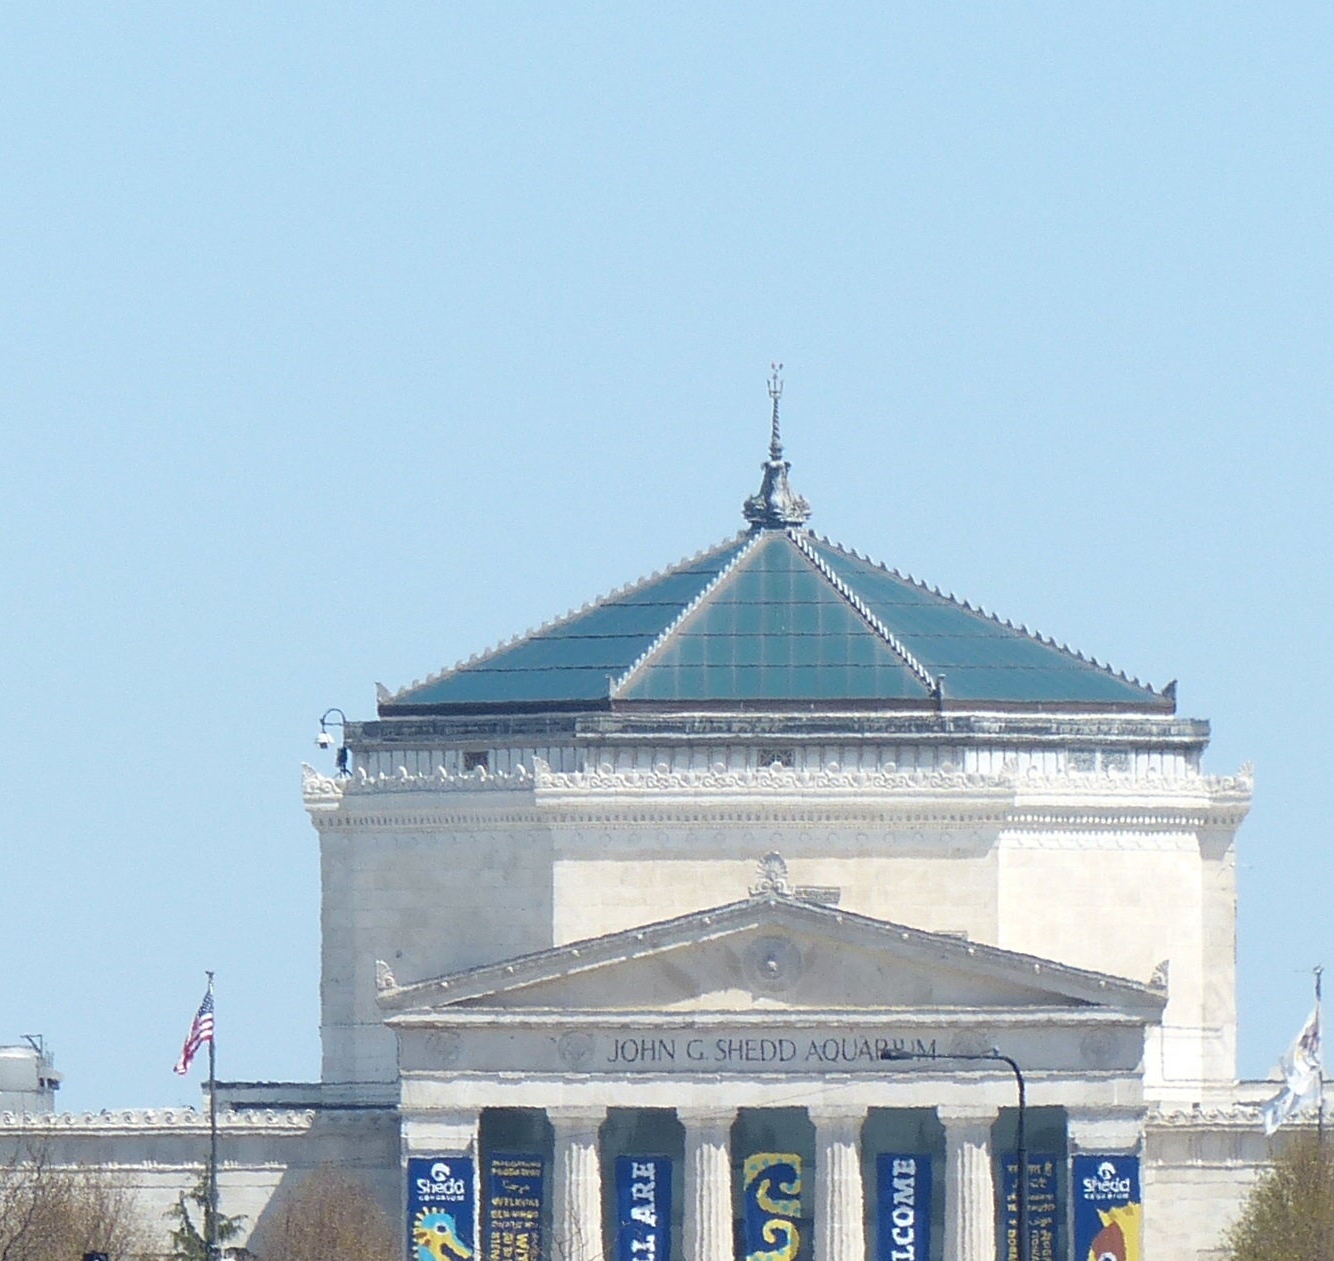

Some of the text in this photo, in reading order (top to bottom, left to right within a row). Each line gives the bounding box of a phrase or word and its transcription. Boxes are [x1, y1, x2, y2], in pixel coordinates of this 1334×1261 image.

[607, 1038, 676, 1062] JOHN
[714, 1038, 796, 1062] SHEDD
[417, 1178, 465, 1194] Shedd
[631, 1162, 657, 1228] ARE
[1083, 1177, 1131, 1193] Shedd
